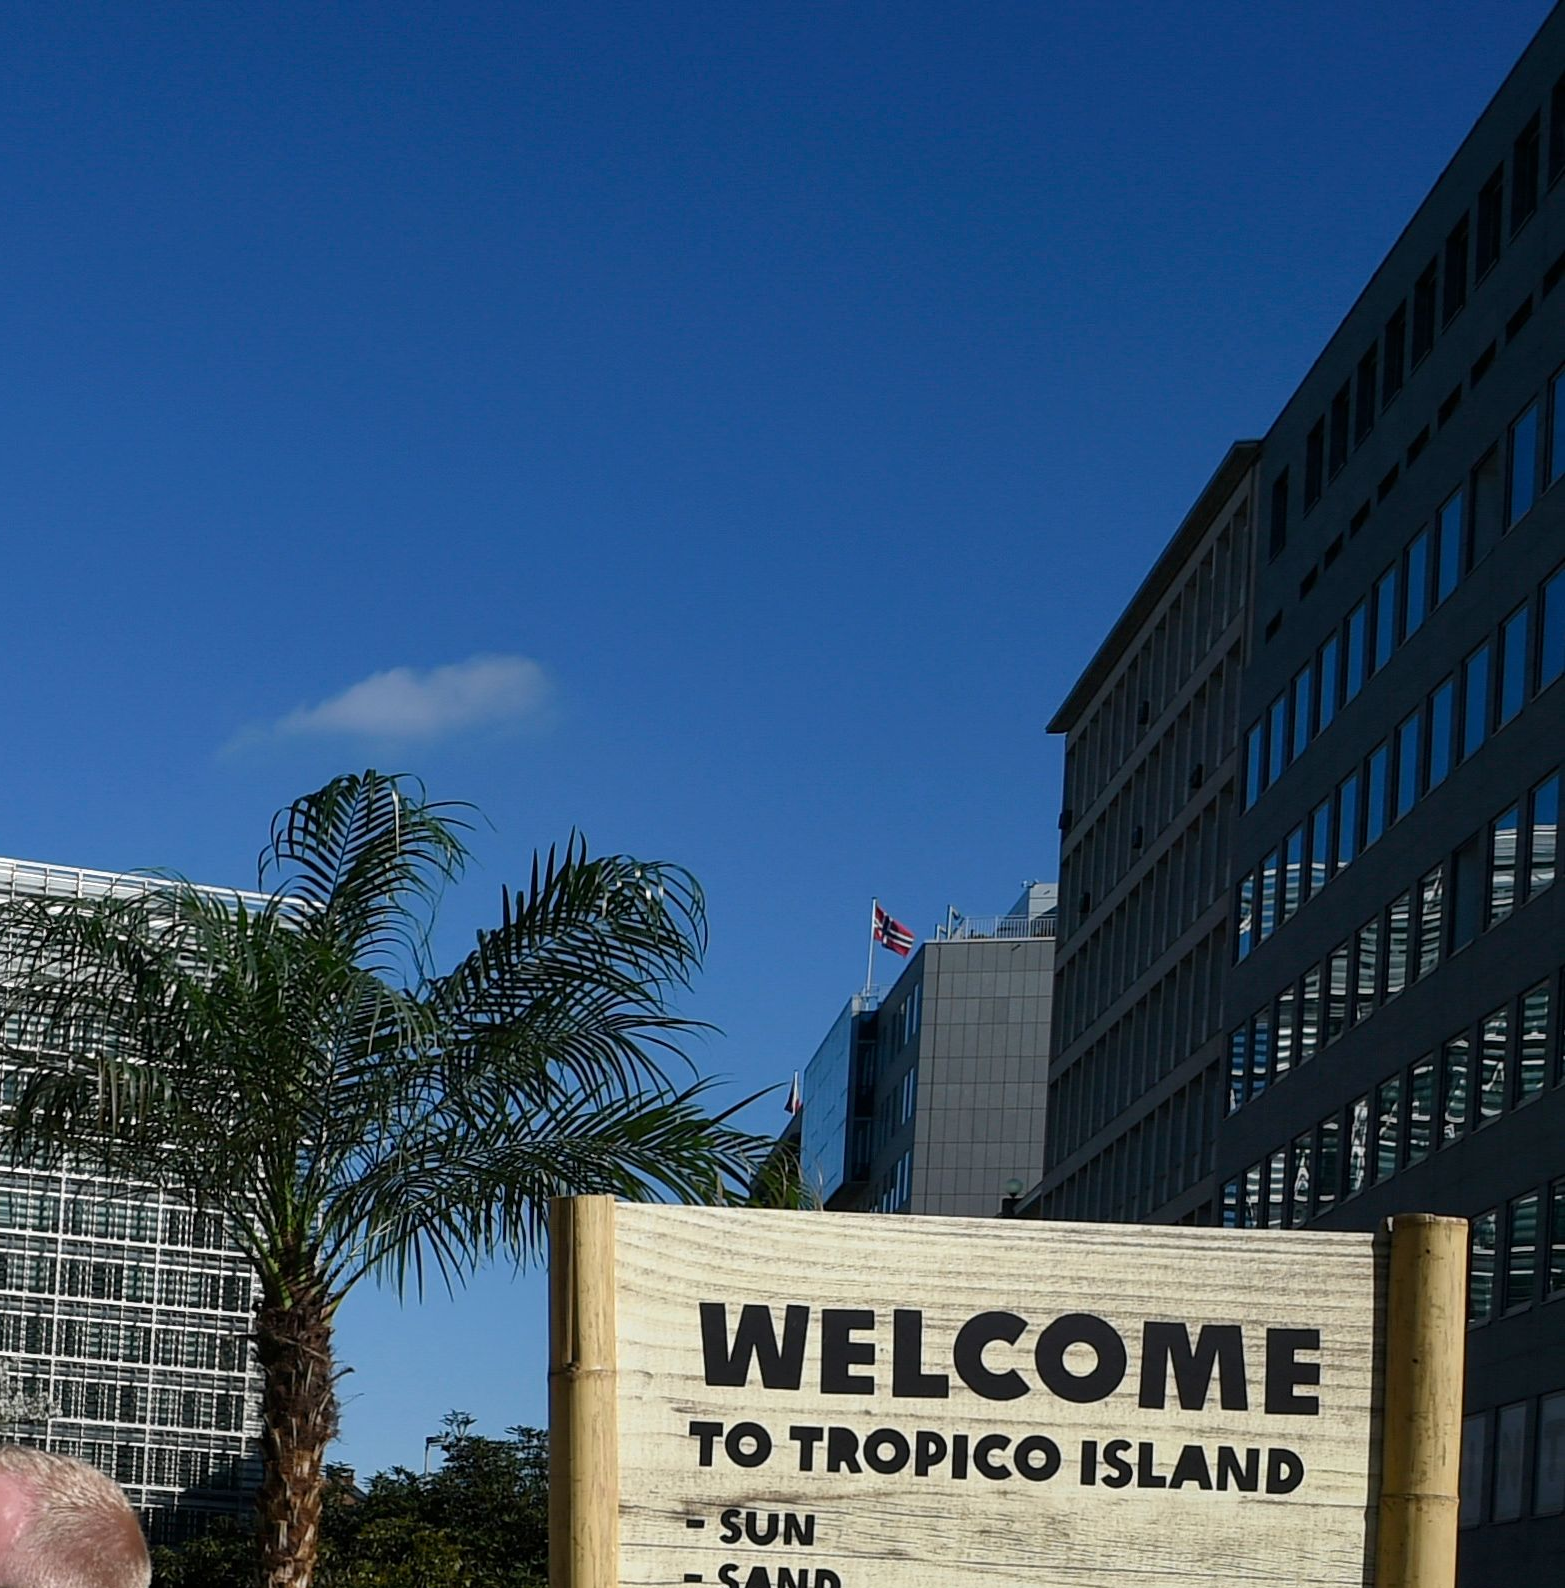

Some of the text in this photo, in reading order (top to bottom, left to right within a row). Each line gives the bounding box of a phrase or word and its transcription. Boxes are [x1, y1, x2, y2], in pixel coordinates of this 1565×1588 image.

[700, 1303, 1320, 1415] WELCOME
[689, 1422, 1303, 1494] TO TROPICO ISLAND
[720, 1509, 814, 1545] SUN
